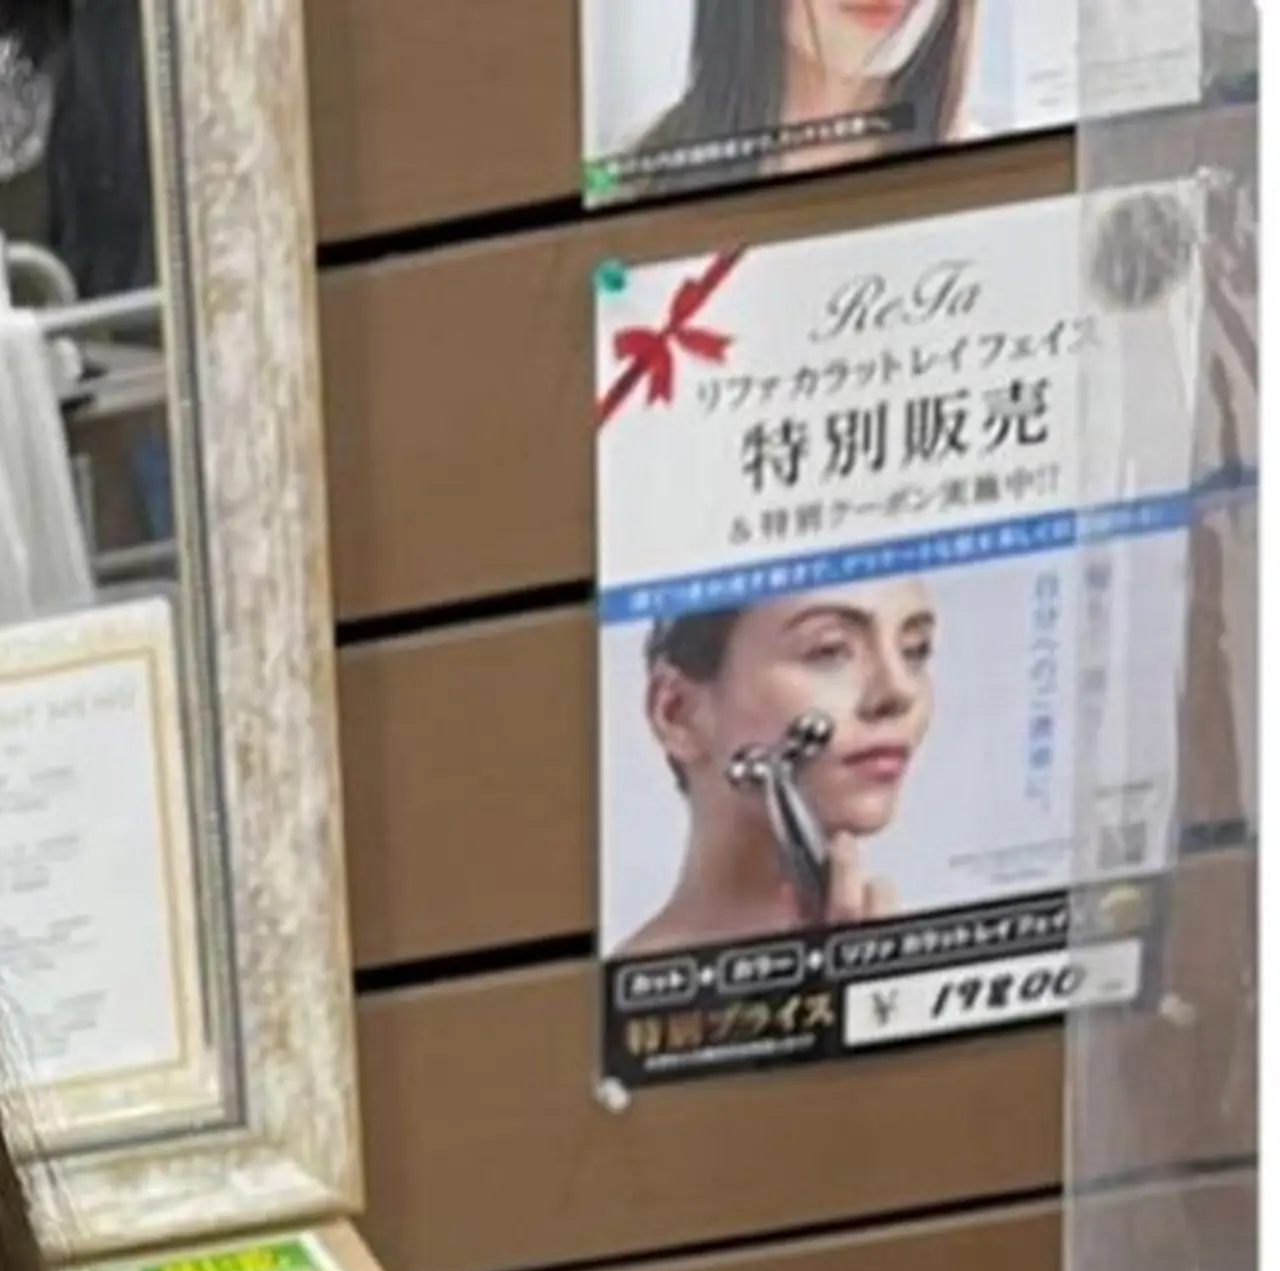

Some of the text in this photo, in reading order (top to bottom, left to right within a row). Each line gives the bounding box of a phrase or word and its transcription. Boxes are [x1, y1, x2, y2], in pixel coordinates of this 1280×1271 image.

[742, 377, 1052, 494] 特別販売
[931, 965, 1086, 1020] 19800
